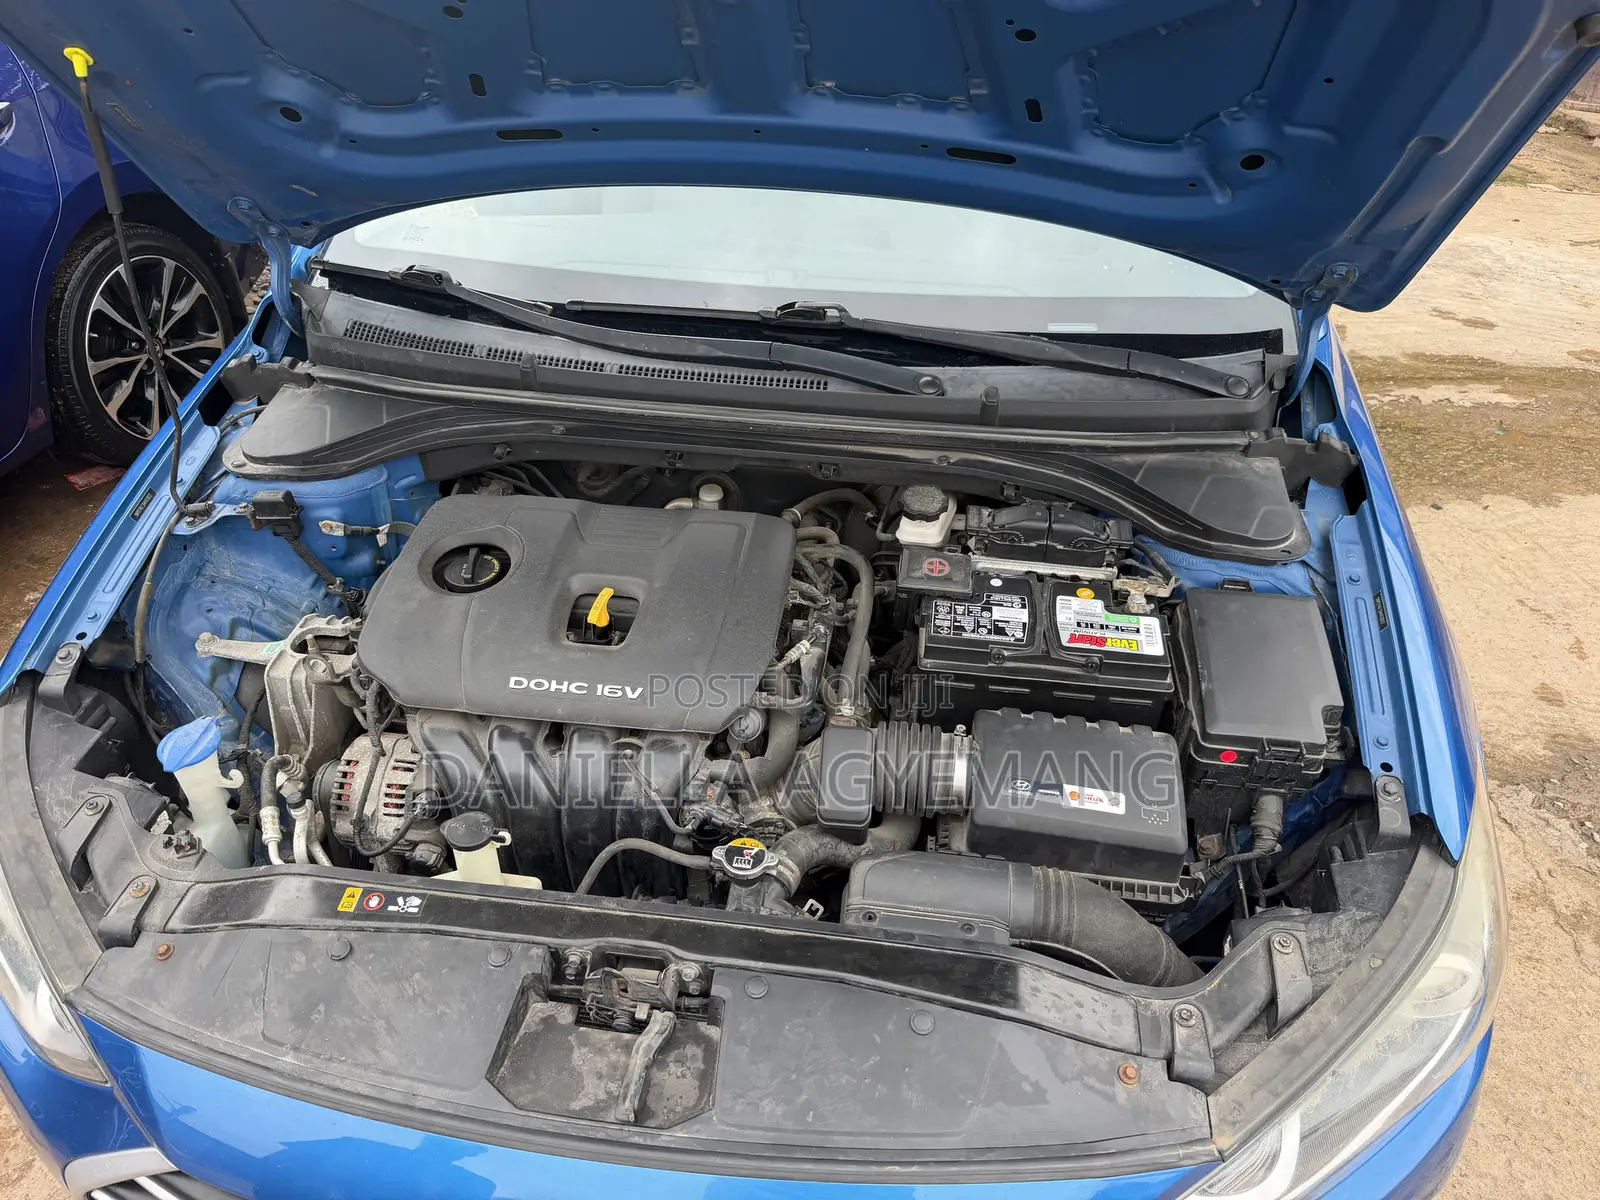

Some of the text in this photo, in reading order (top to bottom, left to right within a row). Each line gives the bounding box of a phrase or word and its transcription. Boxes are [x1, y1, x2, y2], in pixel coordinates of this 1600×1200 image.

[1068, 633, 1138, 651] EverStart
[508, 676, 645, 701] DOHC 16V
